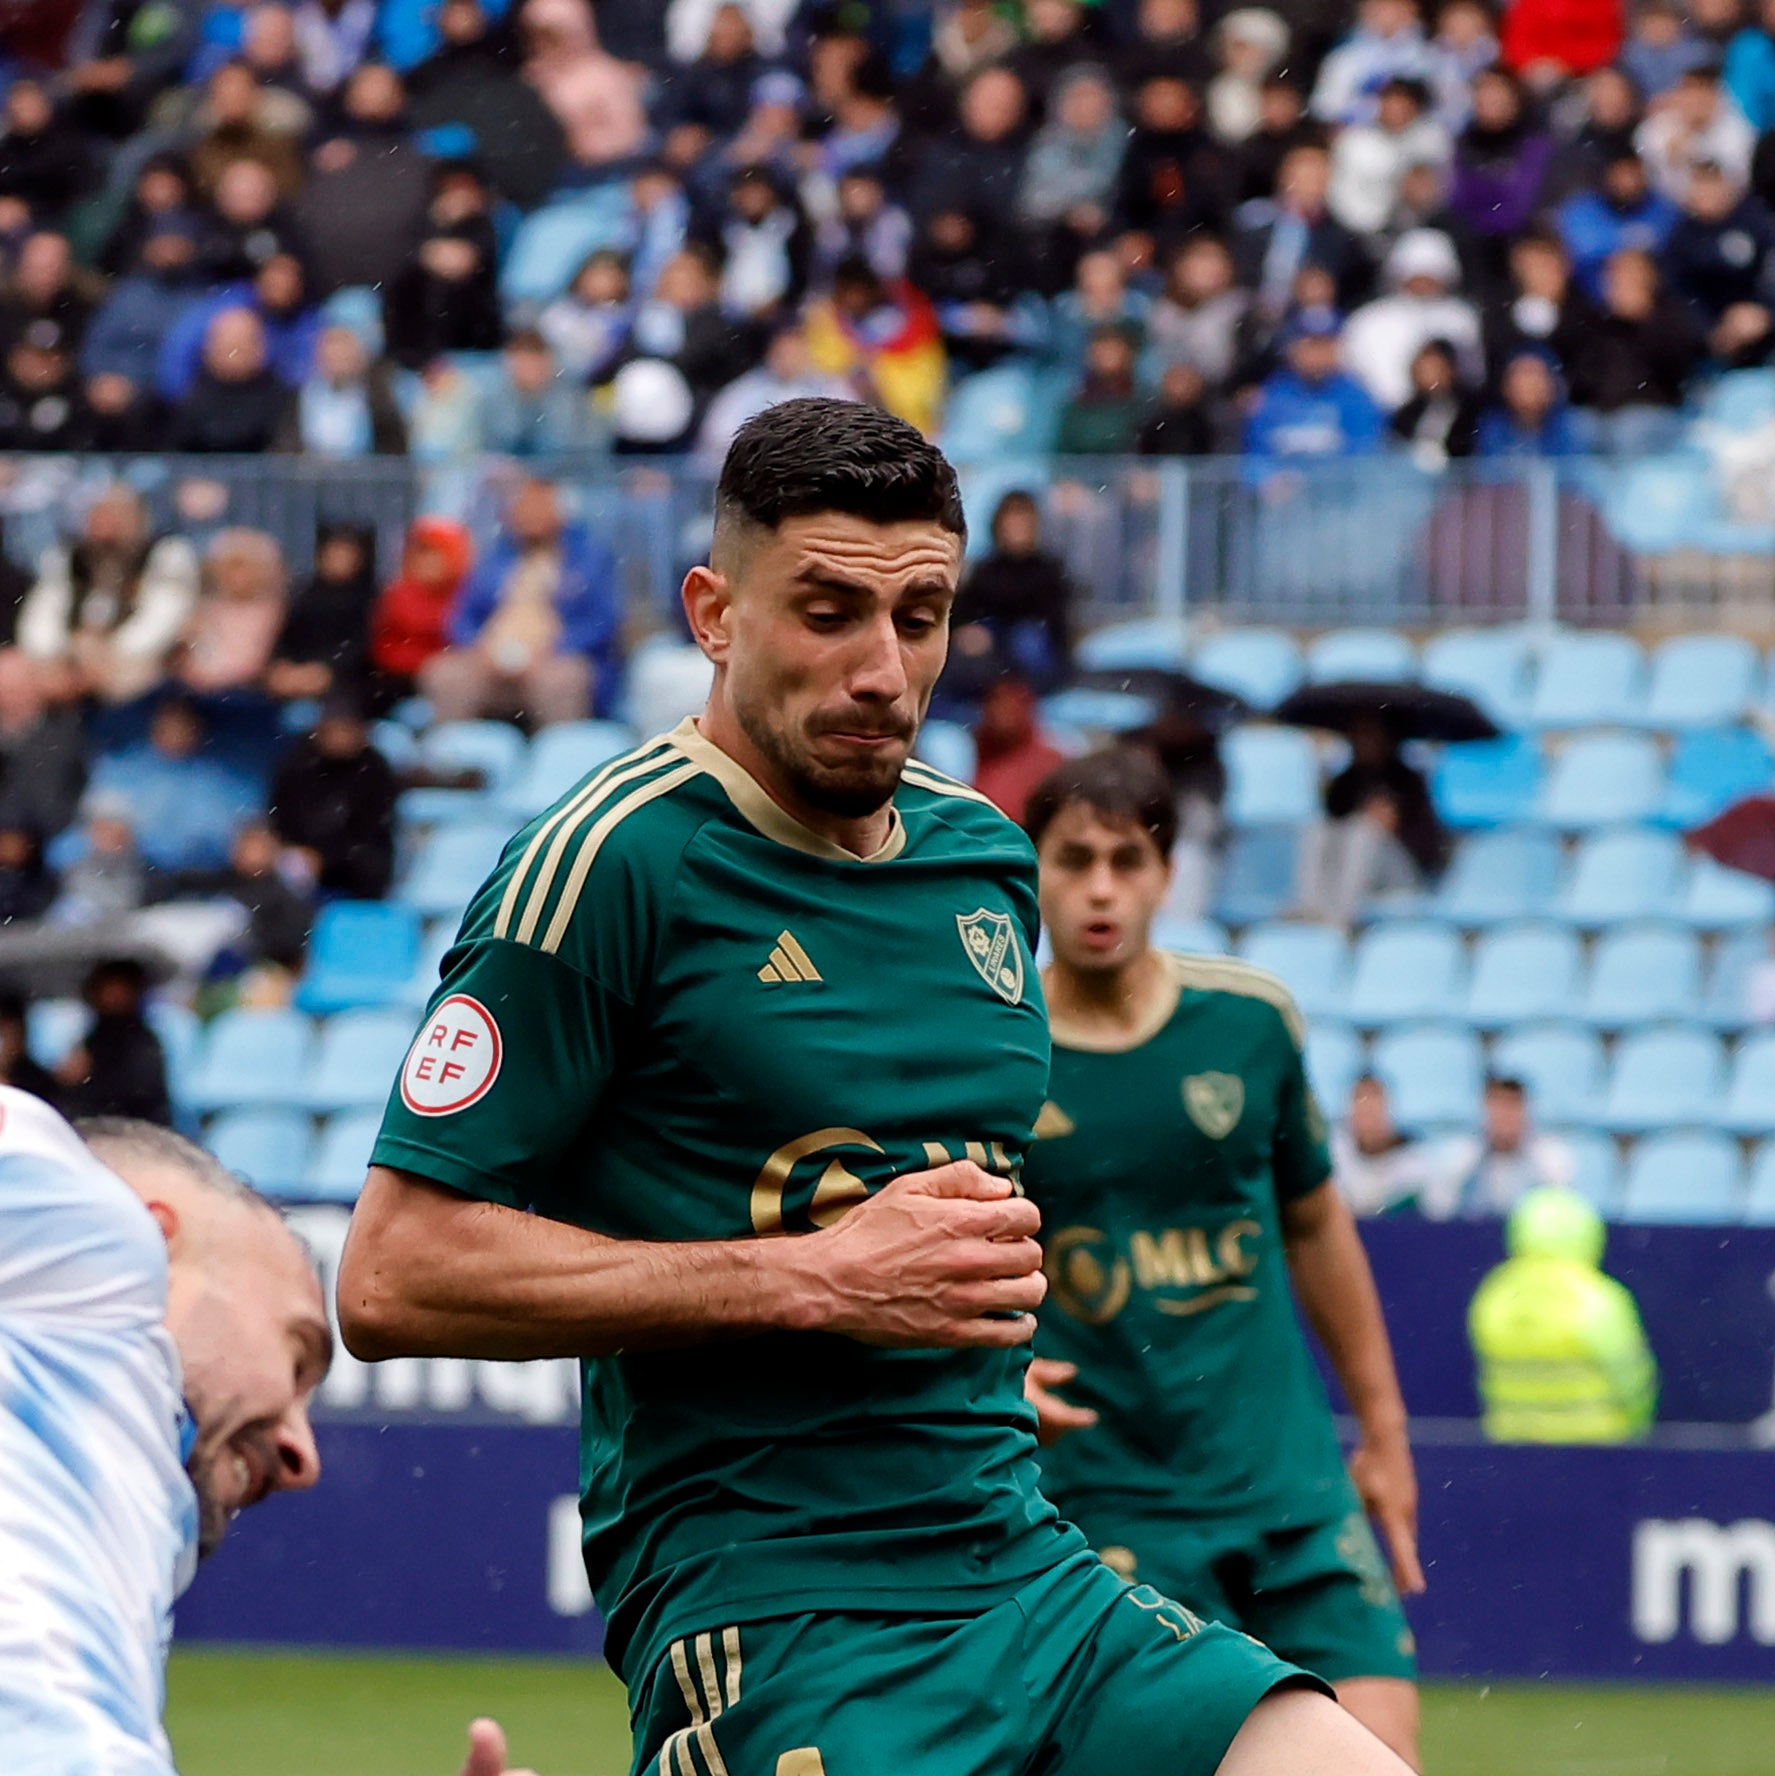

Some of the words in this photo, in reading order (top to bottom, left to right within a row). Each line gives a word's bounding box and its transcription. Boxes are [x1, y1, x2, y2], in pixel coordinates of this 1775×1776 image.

[428, 1024, 479, 1052] RF
[415, 1056, 466, 1085] EF
[1129, 1217, 1264, 1291] MLC
